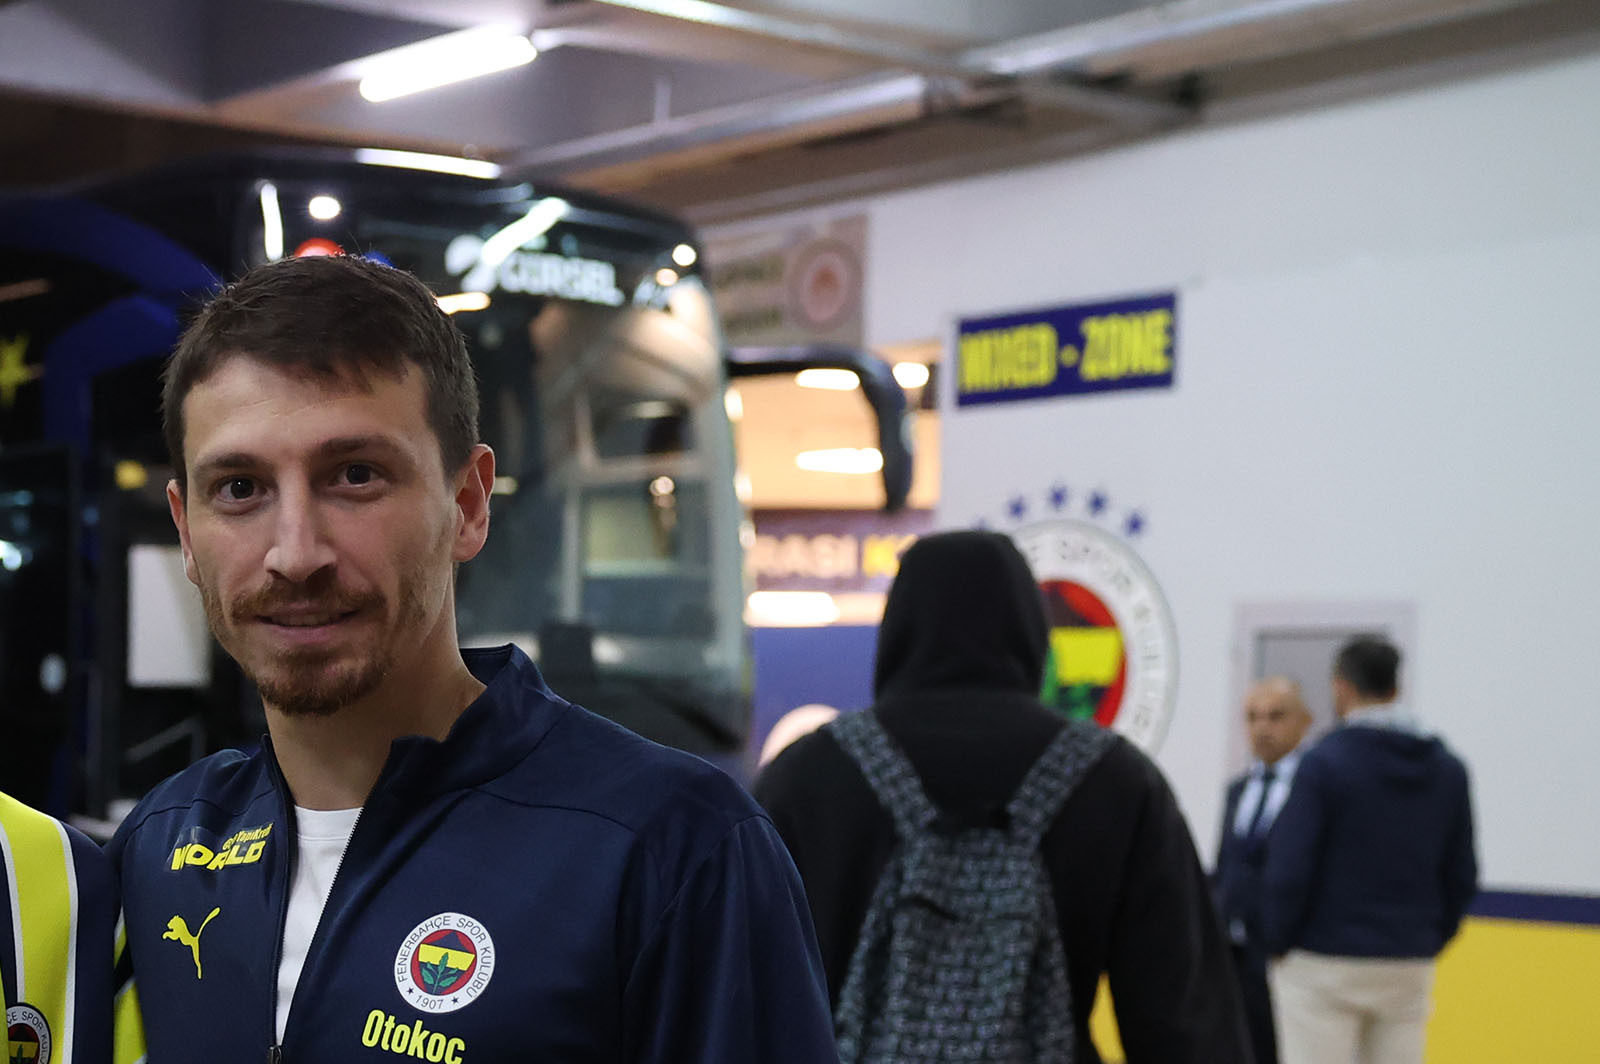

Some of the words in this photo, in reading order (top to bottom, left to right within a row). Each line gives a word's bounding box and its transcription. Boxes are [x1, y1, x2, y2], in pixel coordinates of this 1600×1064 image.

[1080, 309, 1172, 381] ZONE
[397, 915, 452, 983] FENERBAHÇE
[456, 917, 488, 944] SPOR
[466, 946, 492, 998] KULÜBÜ
[415, 995, 444, 1010] 1907
